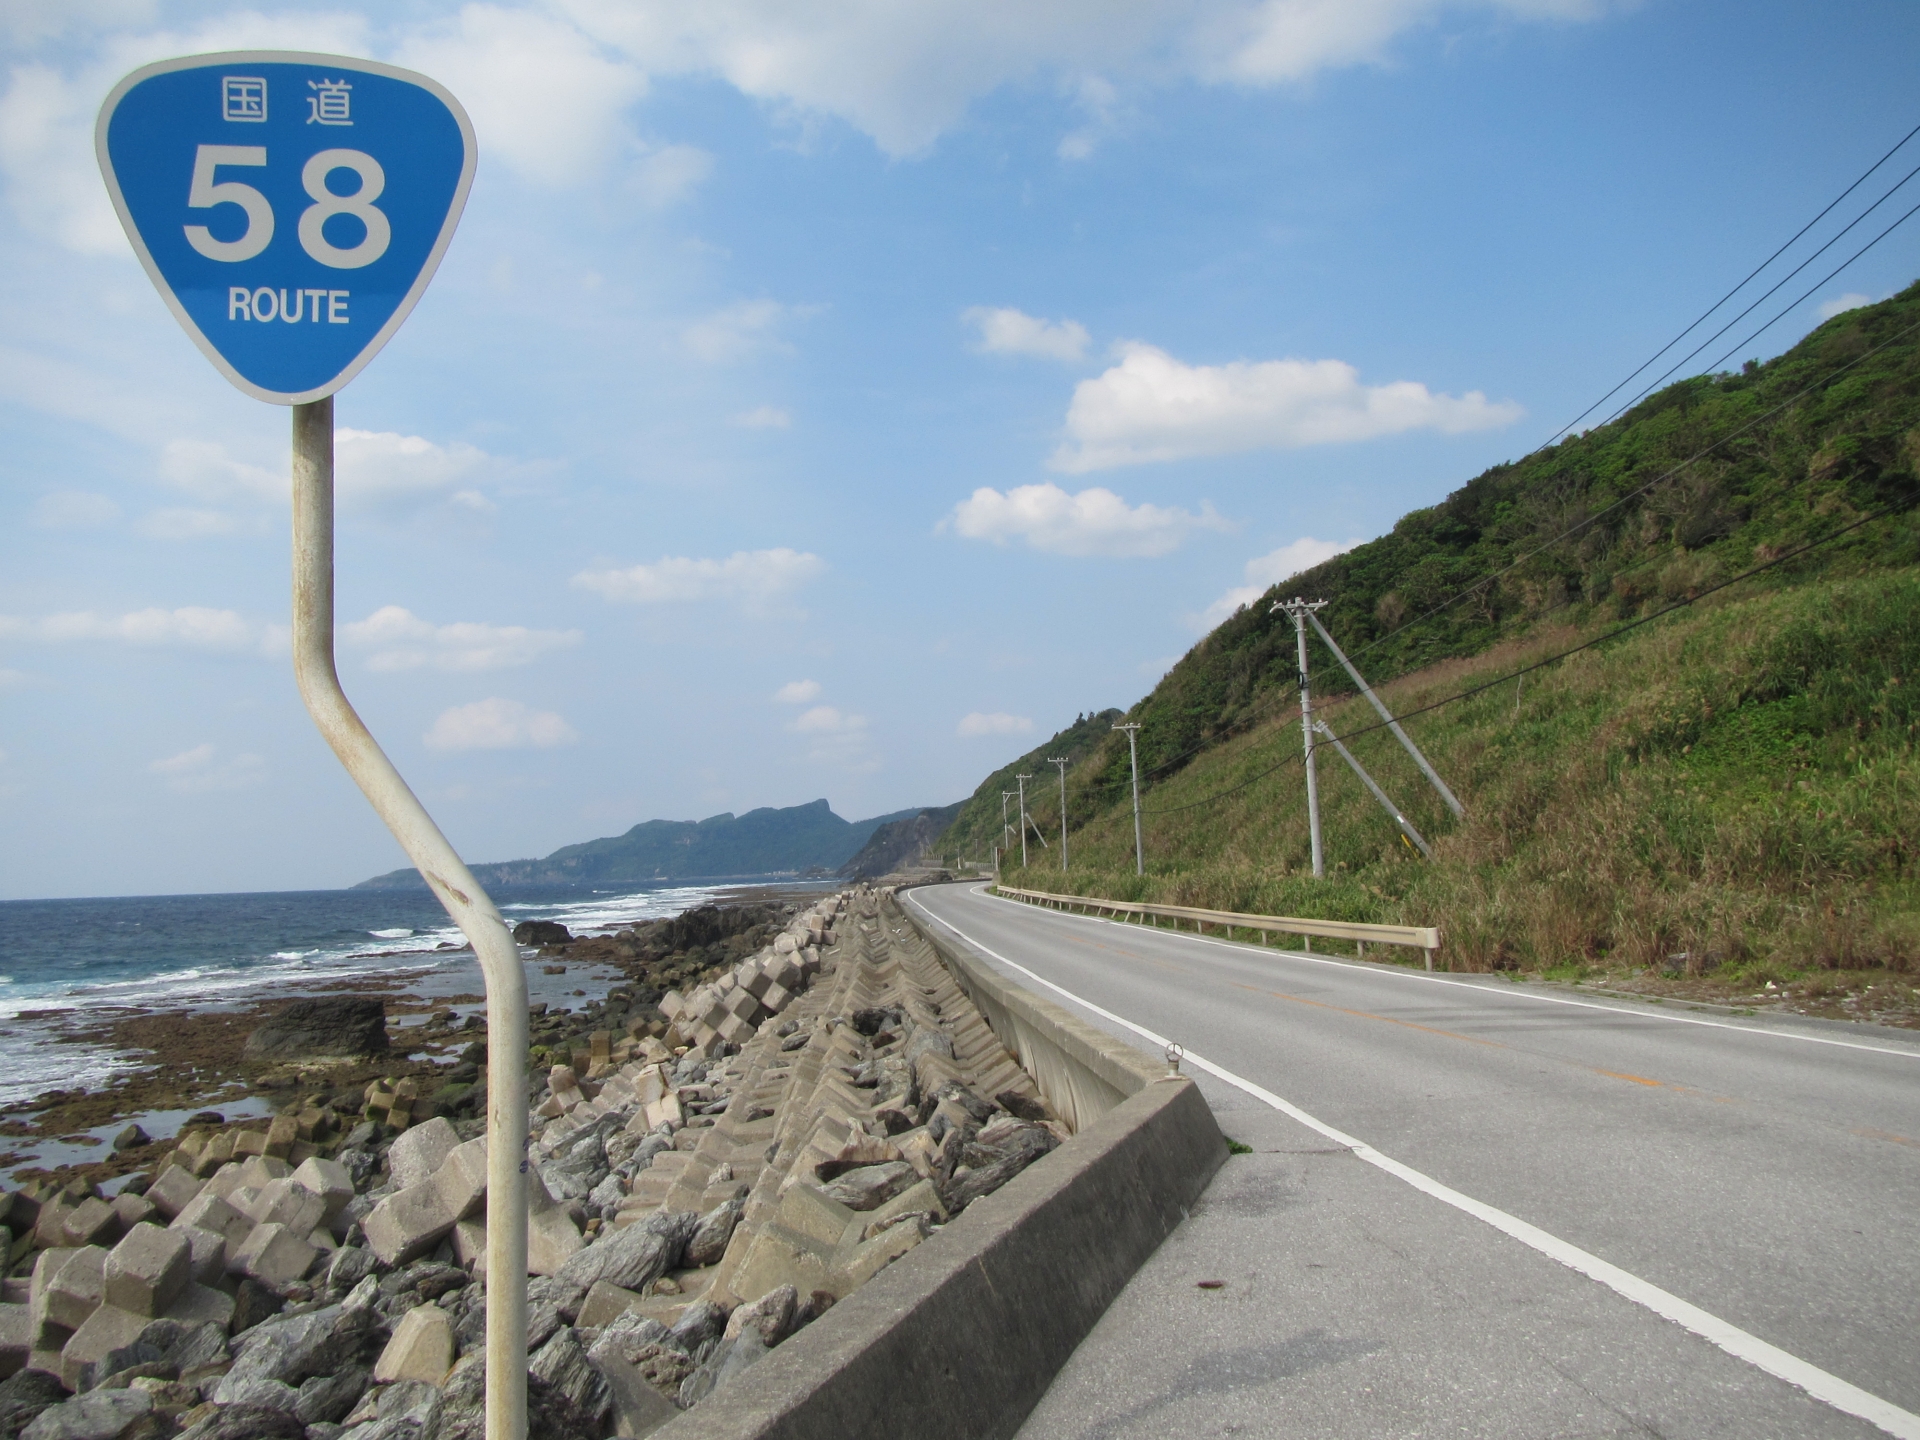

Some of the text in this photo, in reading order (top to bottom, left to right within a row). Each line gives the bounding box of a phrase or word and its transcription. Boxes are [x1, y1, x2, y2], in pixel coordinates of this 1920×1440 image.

[222, 76, 353, 126] 国道
[183, 144, 391, 269] 58
[229, 286, 350, 323] ROUTE
